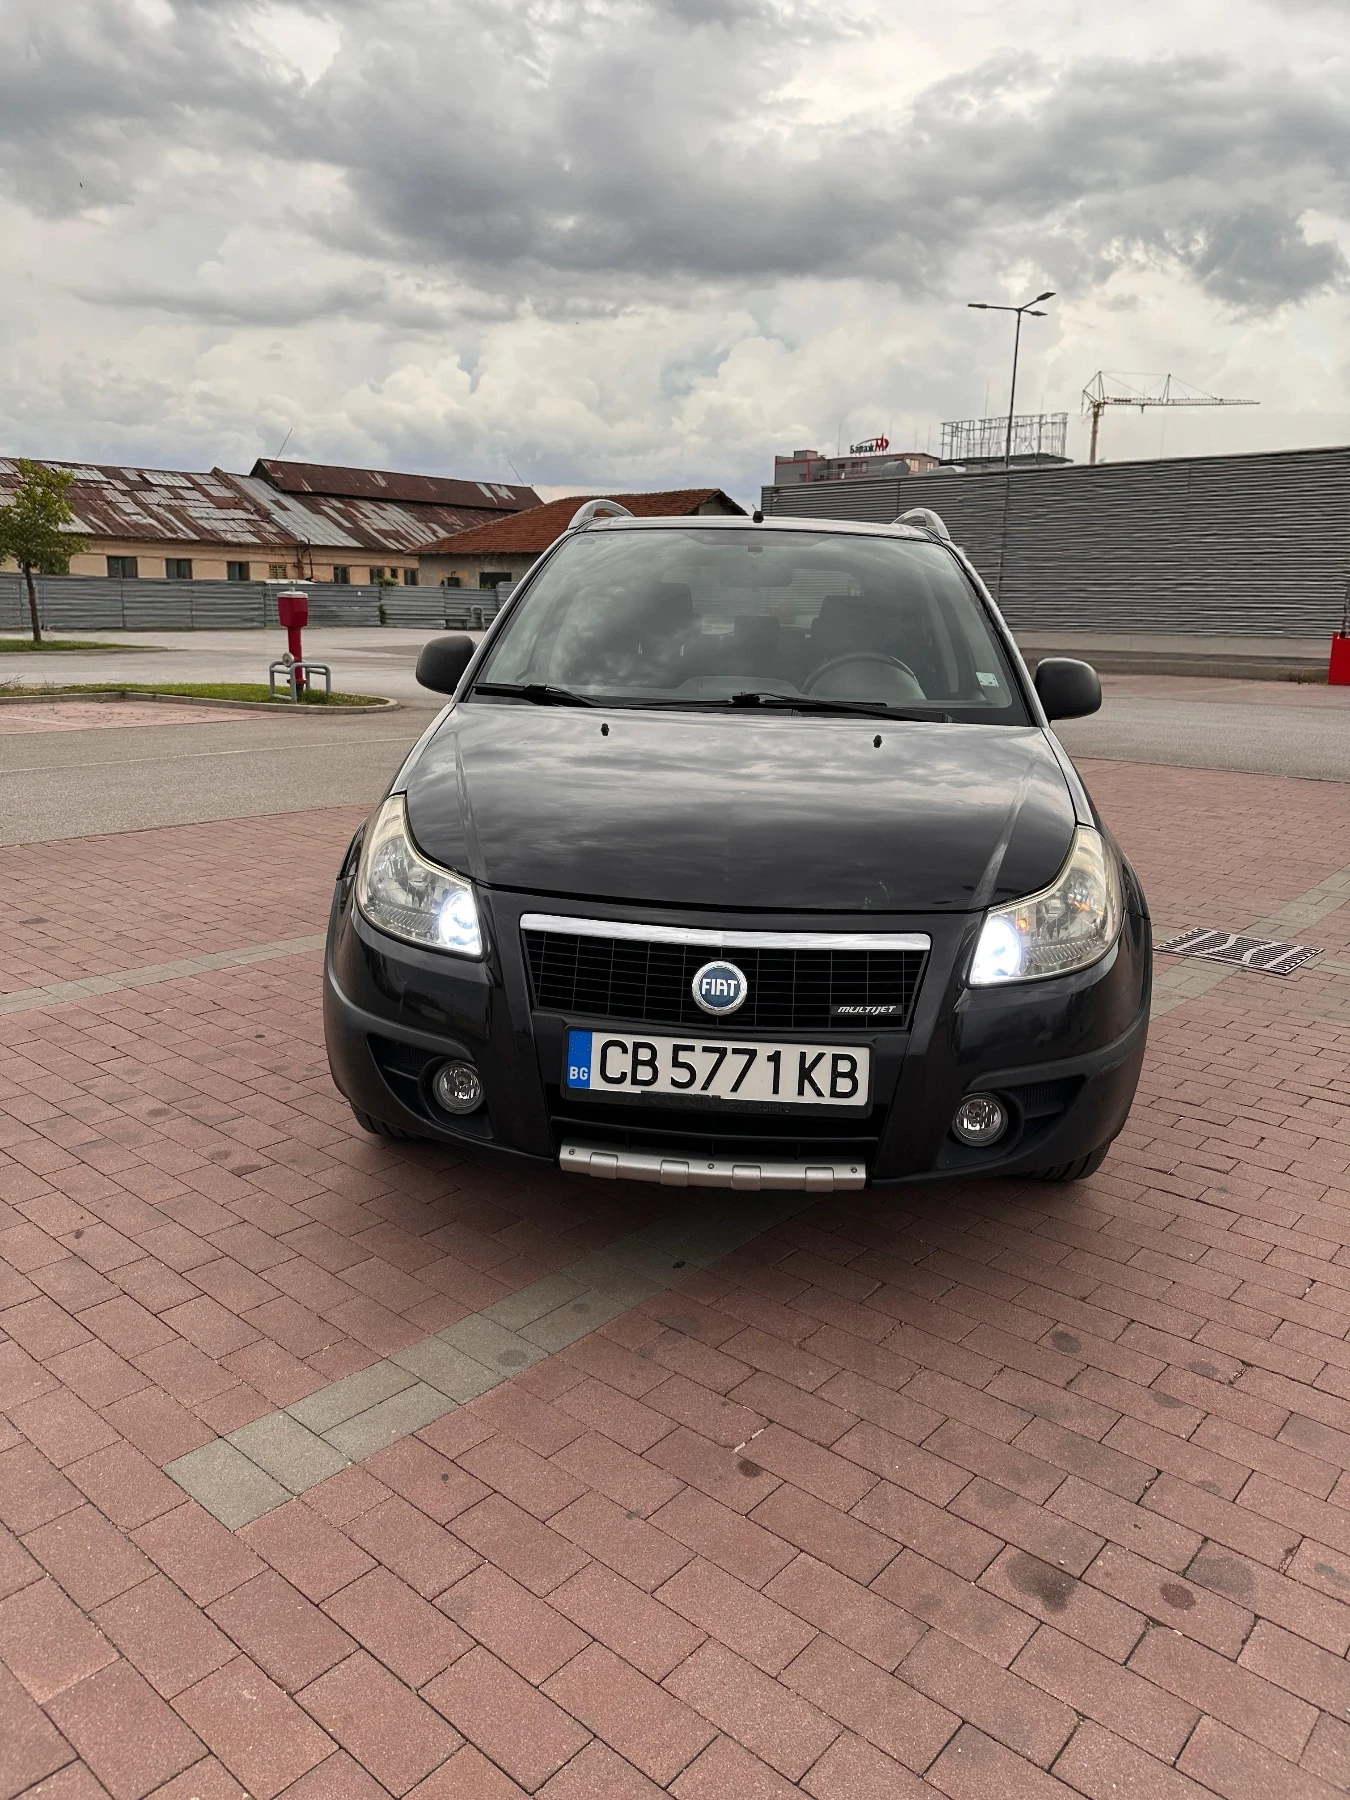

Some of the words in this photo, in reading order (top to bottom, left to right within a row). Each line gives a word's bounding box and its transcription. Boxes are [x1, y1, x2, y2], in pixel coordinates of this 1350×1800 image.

[701, 978, 738, 997] FIAT
[837, 1005, 896, 1015] MULTIJET
[568, 1066, 589, 1080] BG
[600, 1039, 659, 1086] CB
[670, 1044, 782, 1095] 5771
[797, 1051, 859, 1099] KB
